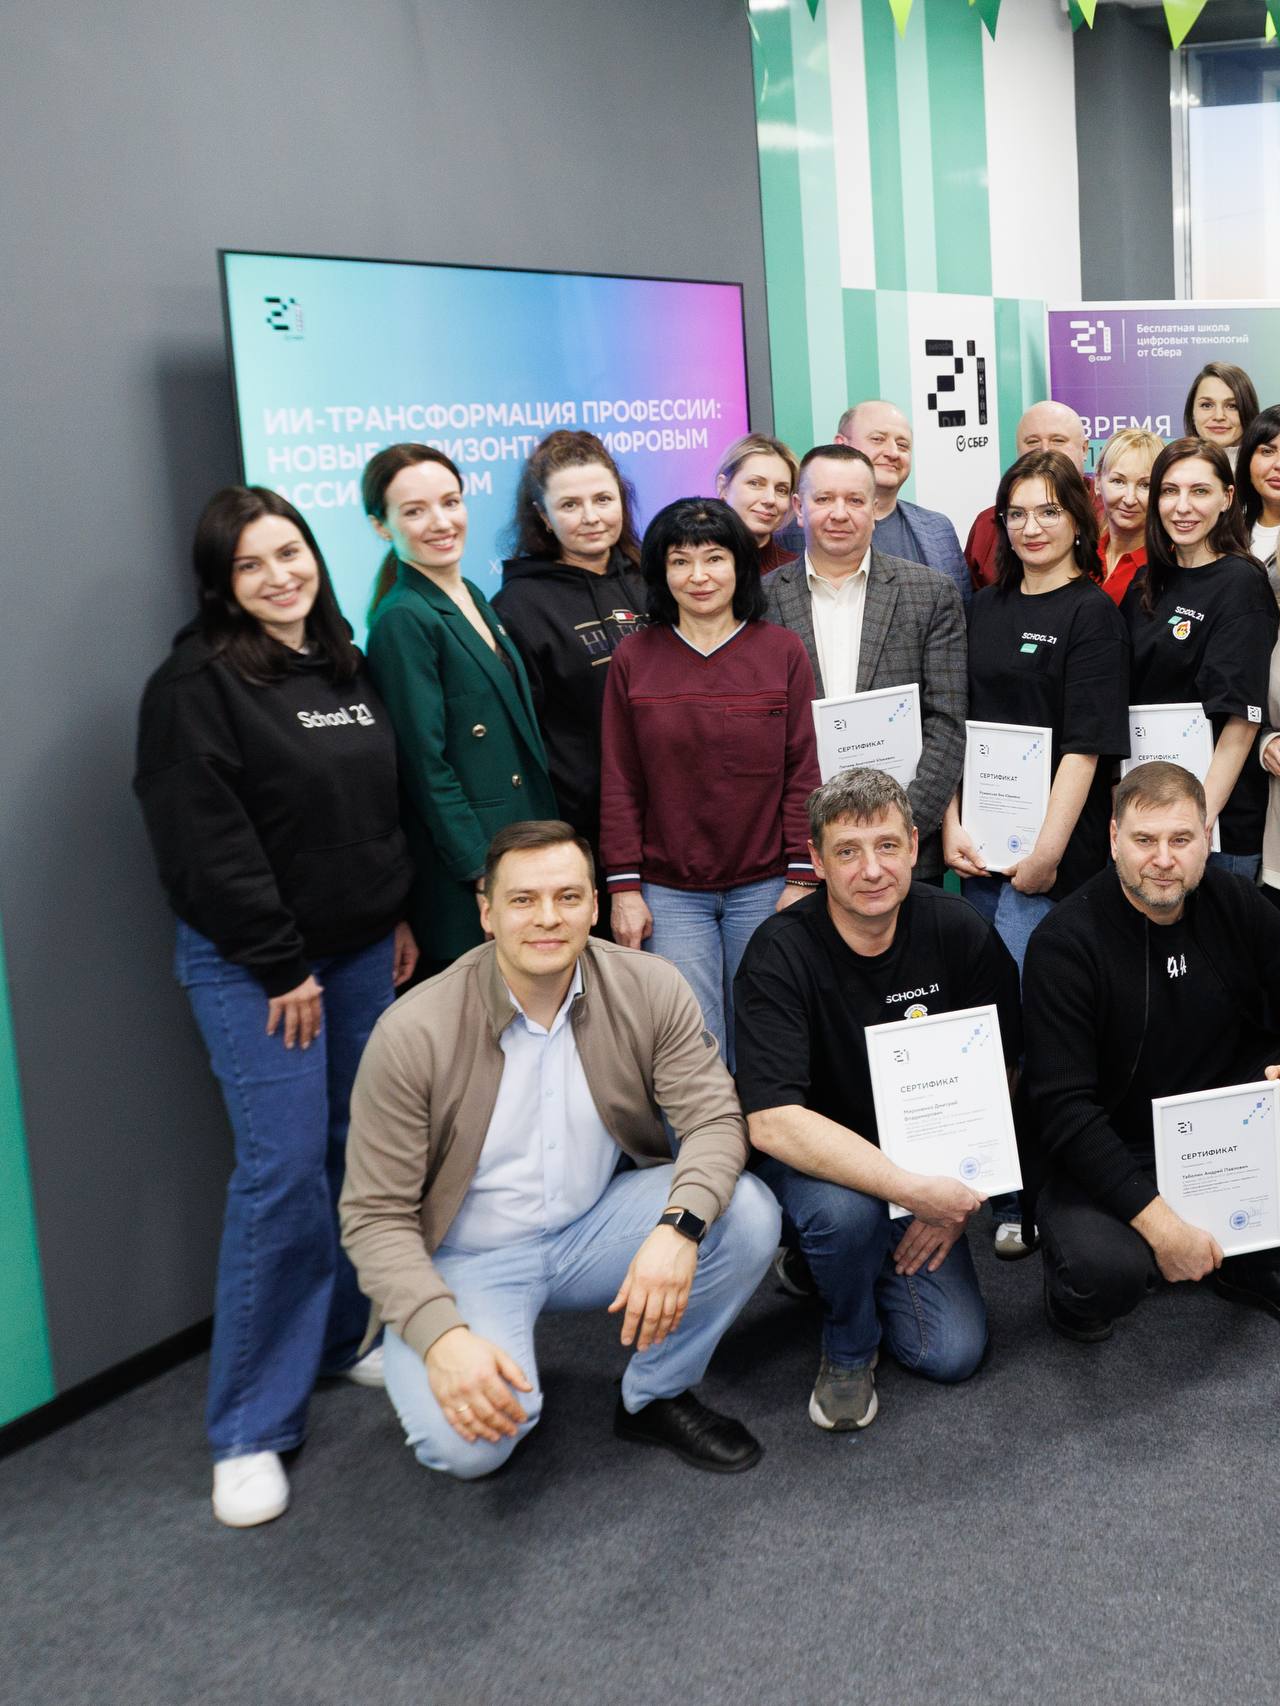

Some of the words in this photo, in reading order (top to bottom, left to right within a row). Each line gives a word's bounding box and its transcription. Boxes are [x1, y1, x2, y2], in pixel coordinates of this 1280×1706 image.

[1137, 323, 1195, 333] Бесплатная
[1197, 324, 1230, 332] школа
[1070, 320, 1111, 353] 21
[1137, 336, 1189, 346] цифровых
[1191, 334, 1249, 345] технологий
[1151, 347, 1182, 358] Сбера
[925, 339, 988, 427] 21
[263, 401, 577, 436] ИИ-ТРАНСФОРМАЦИЯ
[582, 398, 722, 424] ПРОФЕССИИ:
[1080, 414, 1171, 439] ВРЕМЯ
[596, 427, 709, 454] ИФРОВЫМ
[967, 436, 989, 449] СБЕР
[1175, 605, 1197, 618] SCHOOL
[1021, 632, 1047, 642] SCHOOL
[1047, 635, 1058, 645] 21
[296, 706, 356, 729] School
[349, 703, 376, 727] 21
[837, 740, 885, 753] СЕРТИФИКАТ
[1138, 753, 1180, 761] СЕРТИФИКАТ
[979, 772, 1019, 782] СЕРТИФИКАТ
[885, 985, 929, 1004] SCHOOL
[929, 983, 940, 993] 21
[900, 1076, 960, 1094] СЕРТИФИКАТ
[1181, 1145, 1238, 1160] СЕРТИФИКАТ
